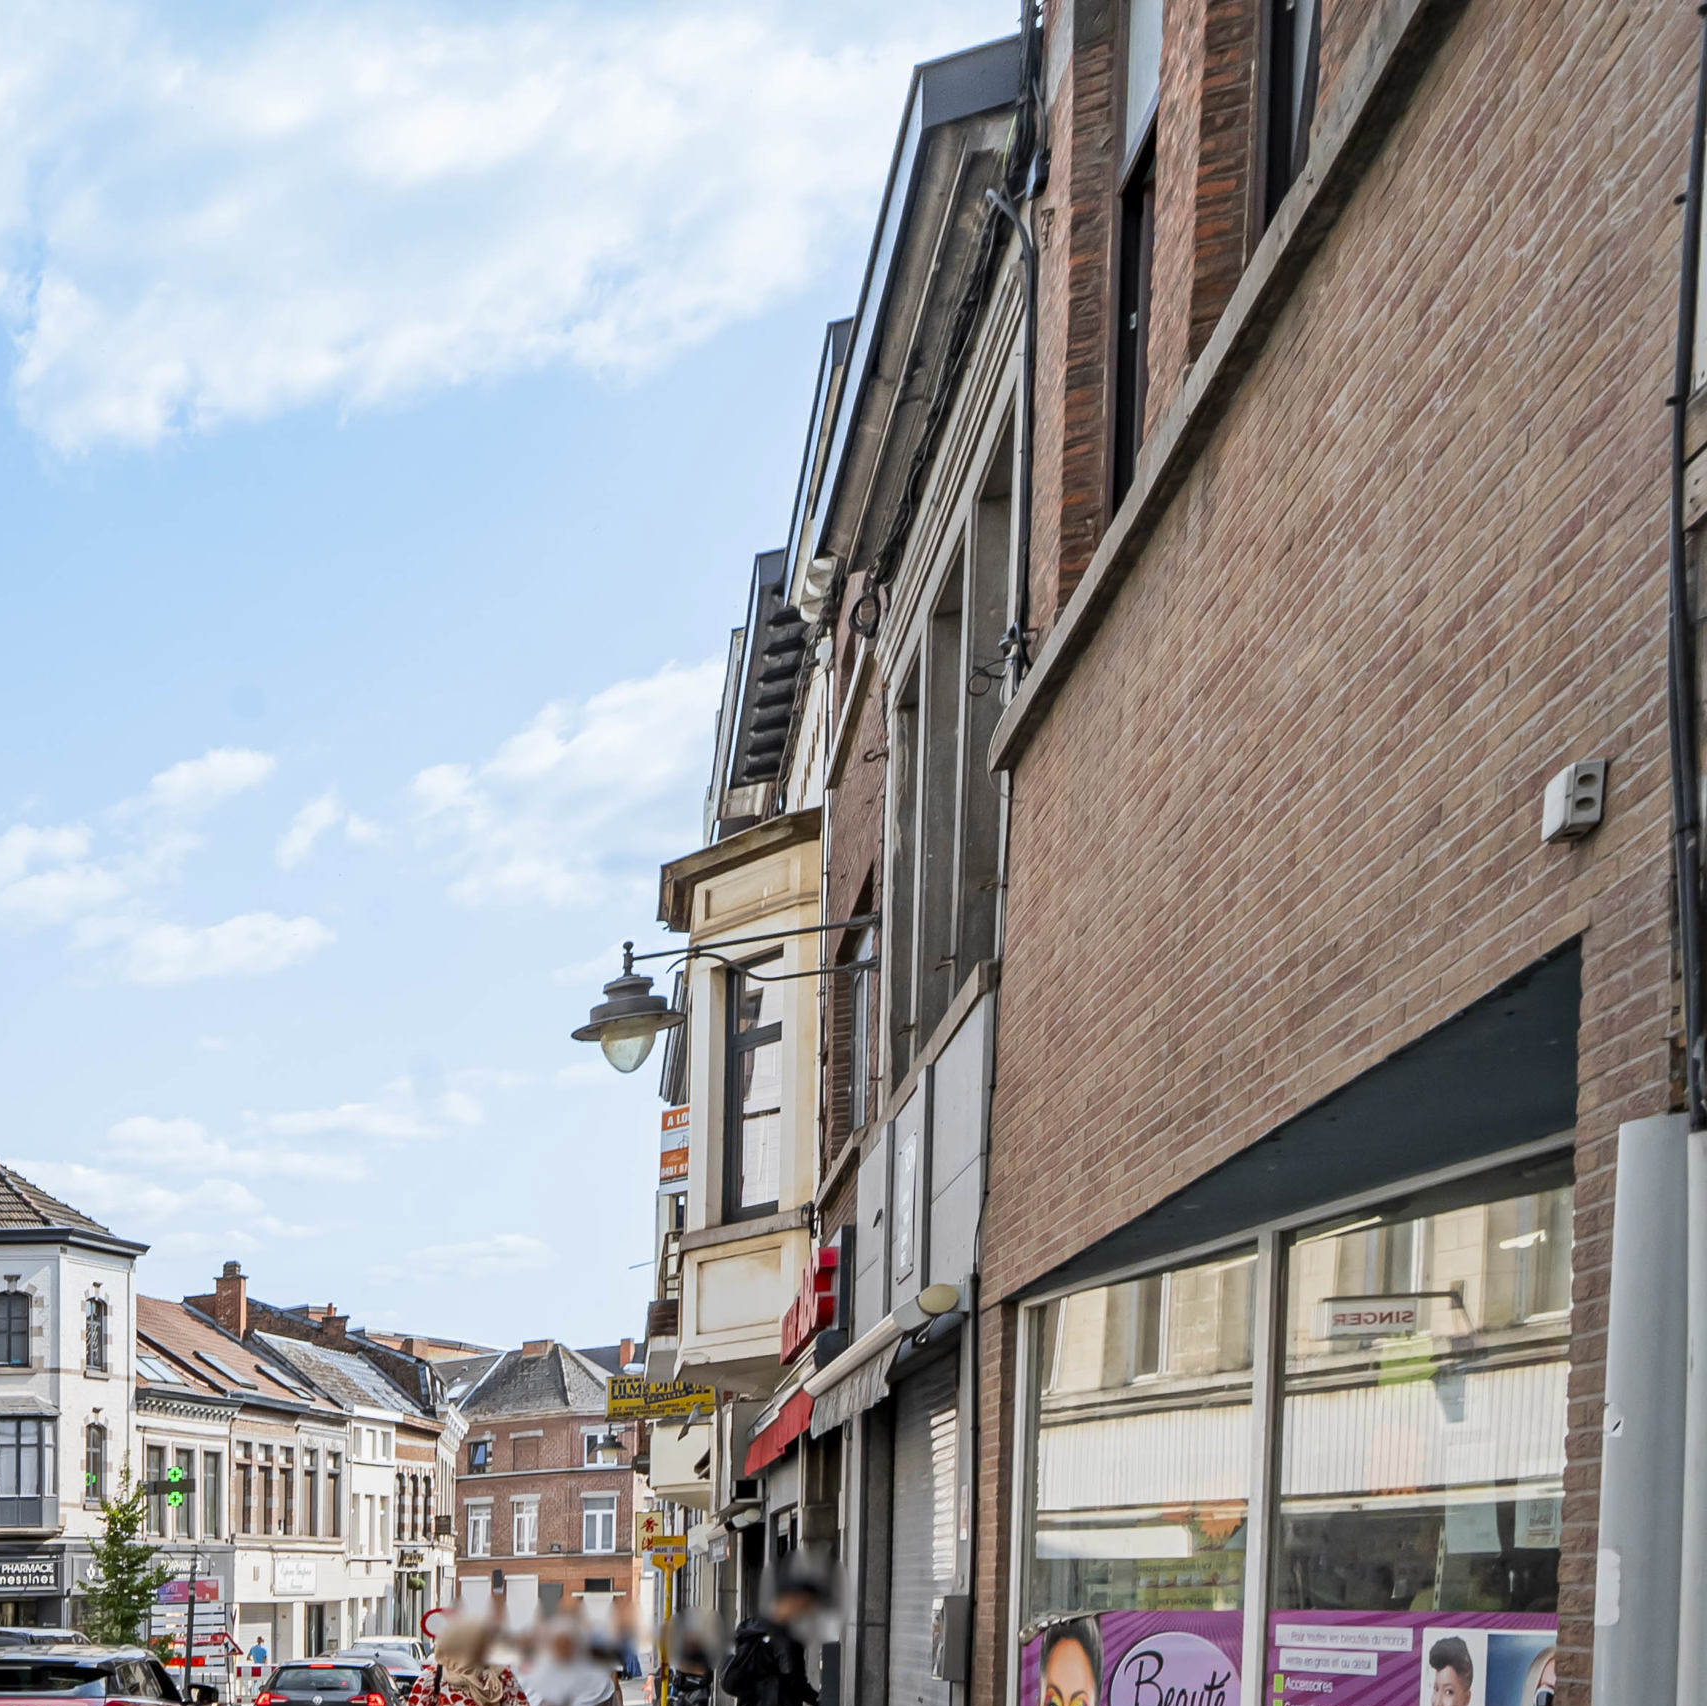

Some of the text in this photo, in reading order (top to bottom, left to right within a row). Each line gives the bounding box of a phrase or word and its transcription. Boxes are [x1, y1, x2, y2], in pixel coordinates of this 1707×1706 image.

[1, 1562, 54, 1574] PHARMACIE
[1371, 1634, 1381, 1645] du
[1382, 1634, 1409, 1647] monde
[1304, 1657, 1314, 1667] en
[1315, 1657, 1331, 1670] gros
[1284, 1676, 1334, 1694] Accessoires
